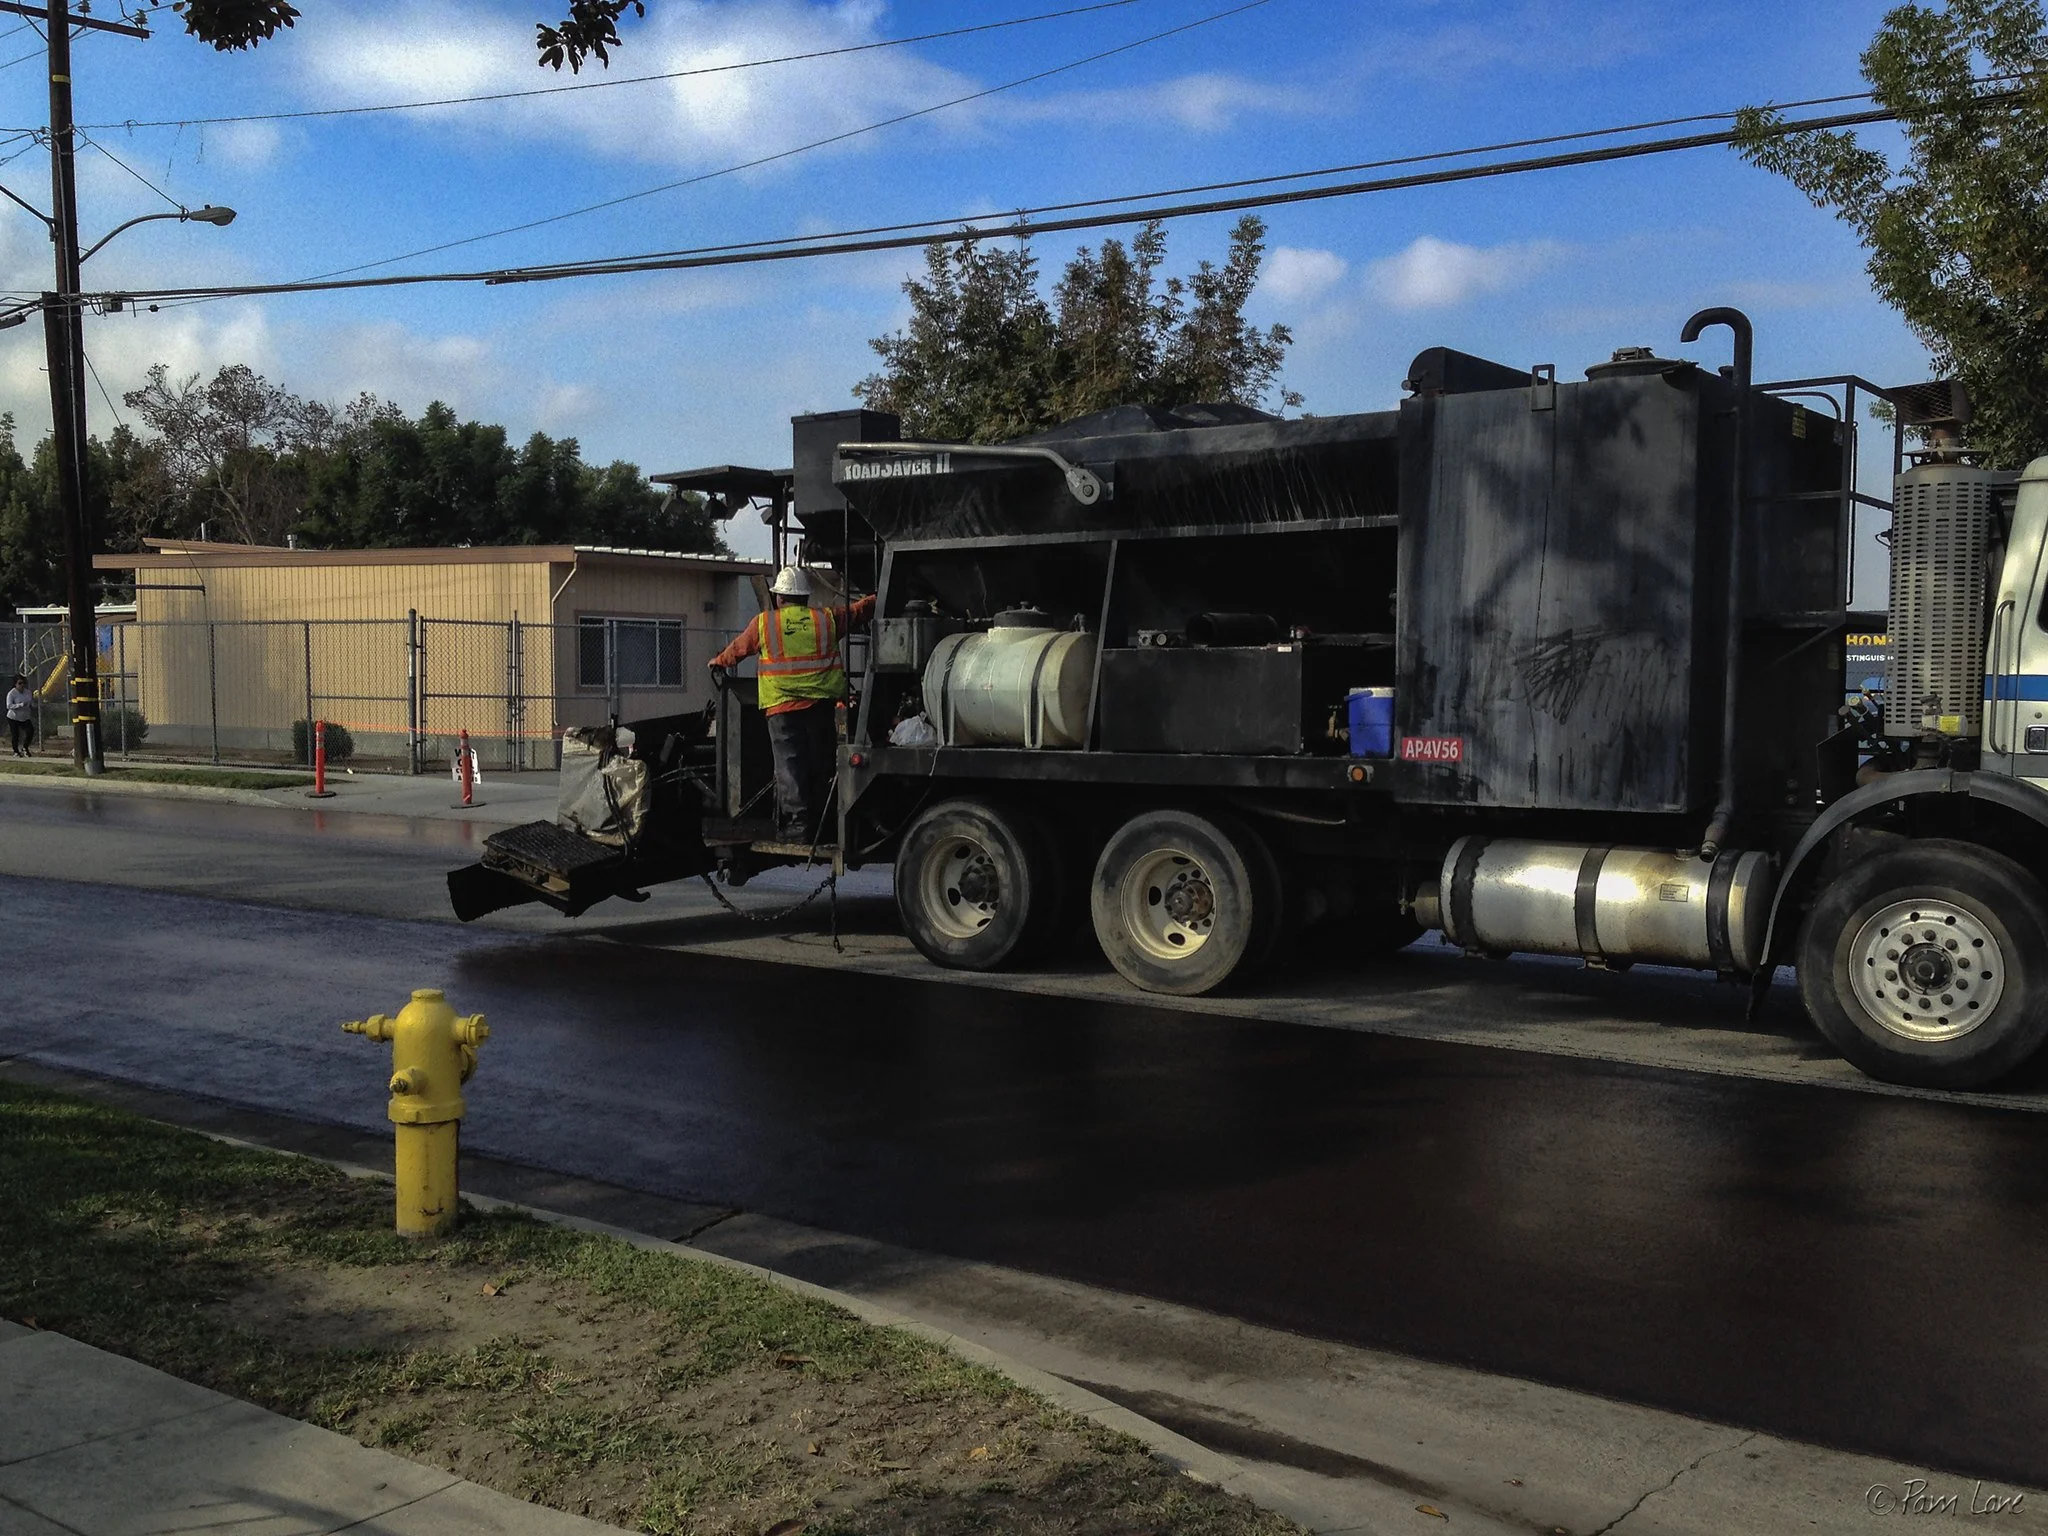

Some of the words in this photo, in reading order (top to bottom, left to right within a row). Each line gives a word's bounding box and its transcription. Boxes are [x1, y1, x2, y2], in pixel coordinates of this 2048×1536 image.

[1846, 634, 1893, 646] HON
[1846, 654, 1894, 662] STINGUIS
[1405, 739, 1459, 759] AP4V56
